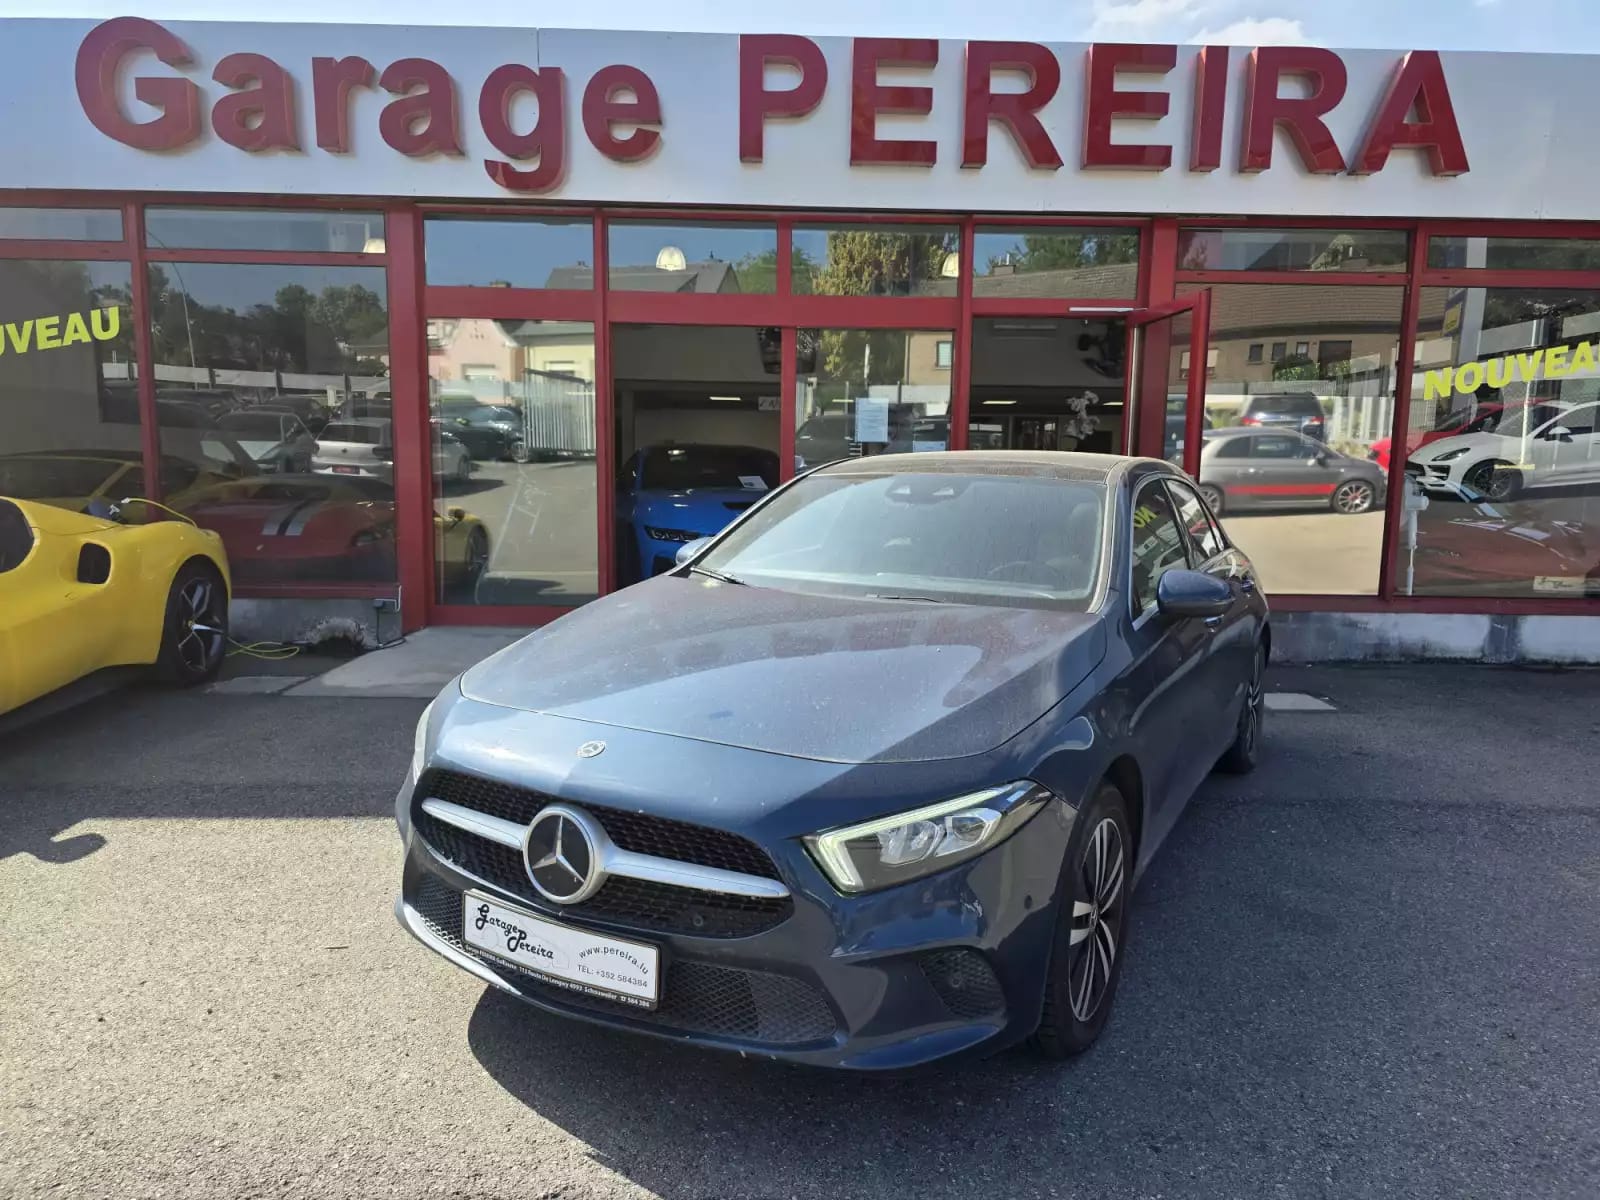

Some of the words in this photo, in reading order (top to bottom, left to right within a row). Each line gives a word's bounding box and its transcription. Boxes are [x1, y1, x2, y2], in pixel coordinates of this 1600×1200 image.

[75, 16, 663, 194] Garage
[738, 34, 1471, 177] PEREIRA
[0, 305, 120, 356] VEAU
[1423, 341, 1600, 401] NOUVEA
[475, 903, 519, 937] Garage
[507, 928, 554, 959] Pereira
[579, 946, 649, 975] www.pereira.lu
[577, 964, 594, 975] TEL:
[596, 969, 615, 981] +352
